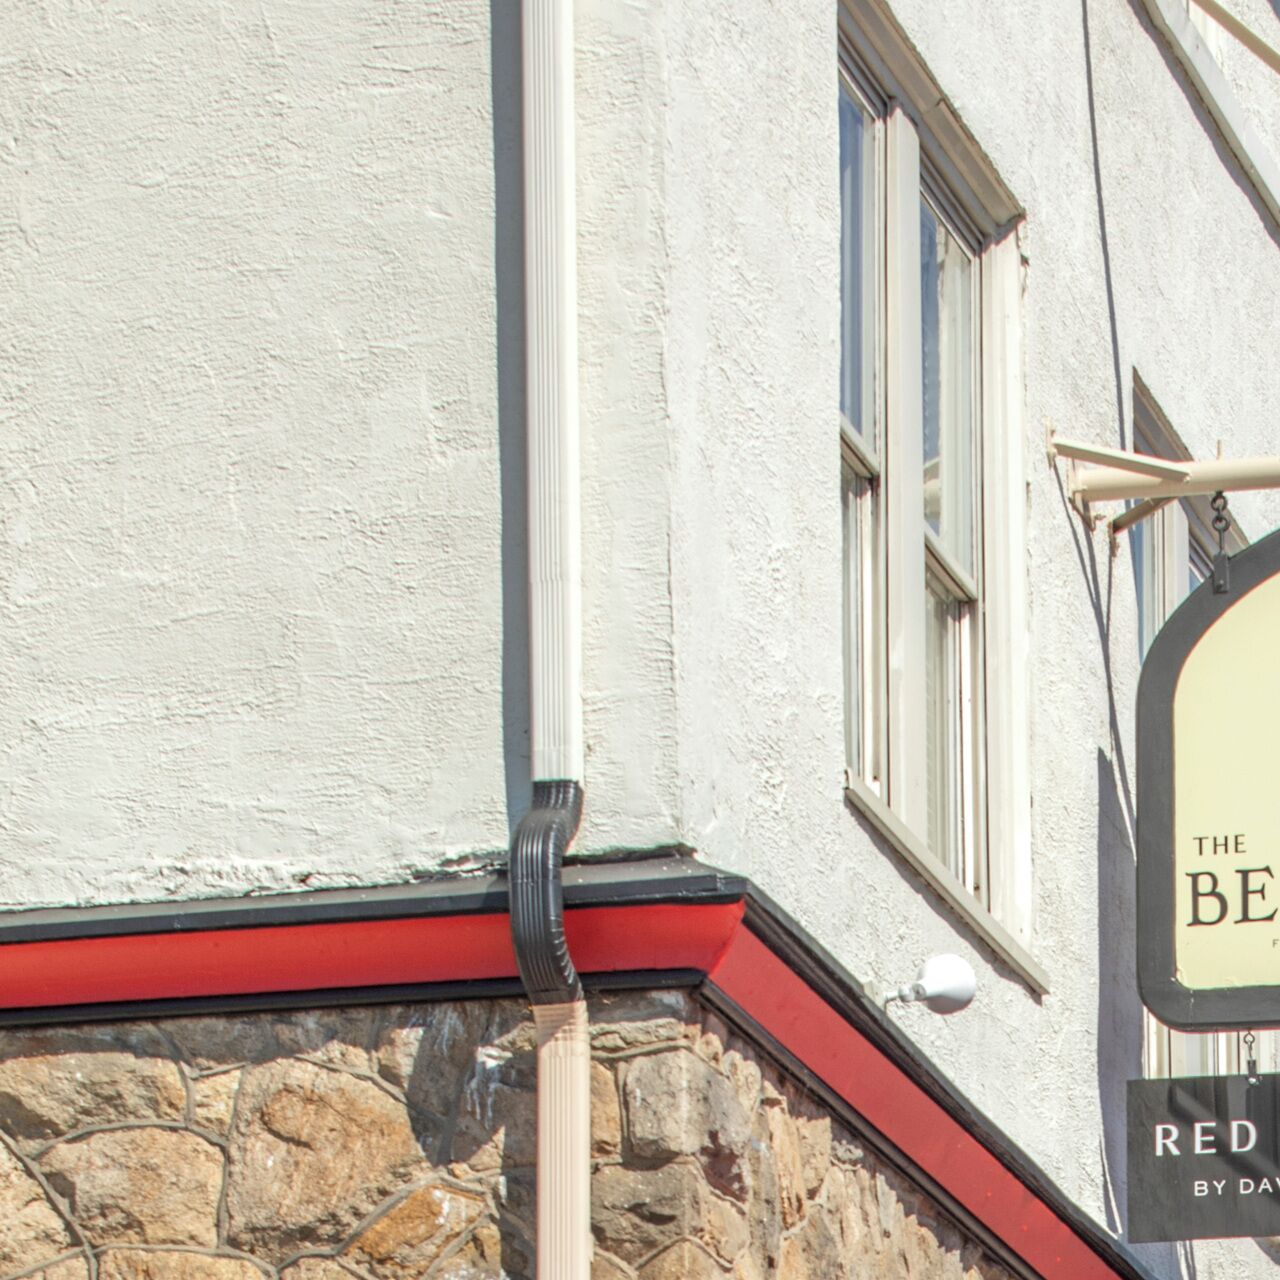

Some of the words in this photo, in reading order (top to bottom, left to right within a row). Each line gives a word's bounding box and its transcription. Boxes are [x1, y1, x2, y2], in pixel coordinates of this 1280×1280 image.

[1193, 834, 1247, 857] THE
[1154, 1120, 1258, 1157] RED
[1194, 1180, 1226, 1196] BY
